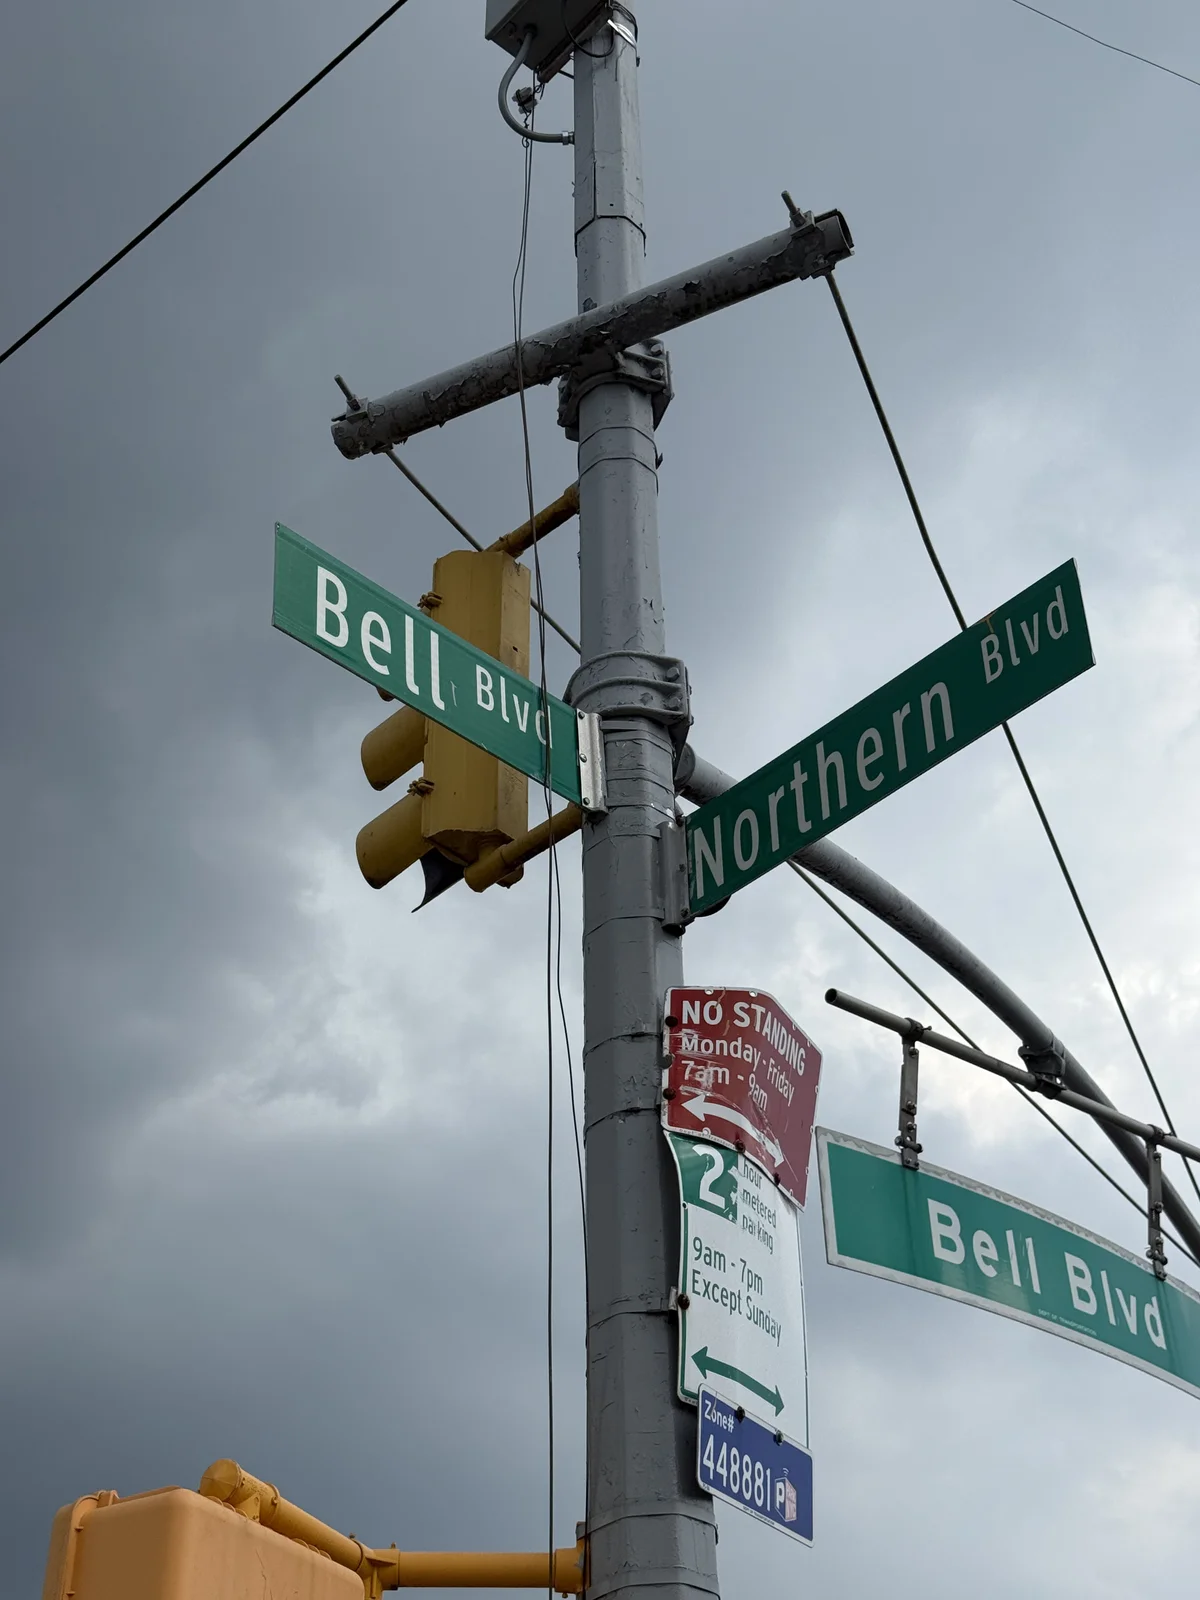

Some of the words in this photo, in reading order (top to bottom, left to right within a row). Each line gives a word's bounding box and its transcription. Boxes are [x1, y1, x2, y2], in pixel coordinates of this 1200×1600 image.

[315, 565, 445, 711] Bell
[475, 664, 553, 749] Blvd
[693, 681, 955, 900] Northern
[980, 585, 1069, 684] Blvd
[681, 1033, 761, 1072] Monday
[767, 1057, 795, 1108] Friday
[682, 1000, 723, 1026] NO
[733, 1001, 806, 1076] STANDING
[681, 1060, 730, 1085] 7am
[748, 1073, 768, 1111] 9am
[692, 1144, 726, 1209] 2
[742, 1188, 777, 1229] metered
[743, 1158, 763, 1189] hour
[692, 1236, 726, 1273] 9am
[739, 1257, 763, 1296] 7pm
[742, 1214, 774, 1255] parking
[692, 1268, 743, 1316] Except
[746, 1295, 782, 1348] Sunday
[927, 1198, 1042, 1294] Bell
[1064, 1251, 1167, 1350] Blvd
[704, 1399, 735, 1433] Zone#
[703, 1434, 771, 1511] 448881
